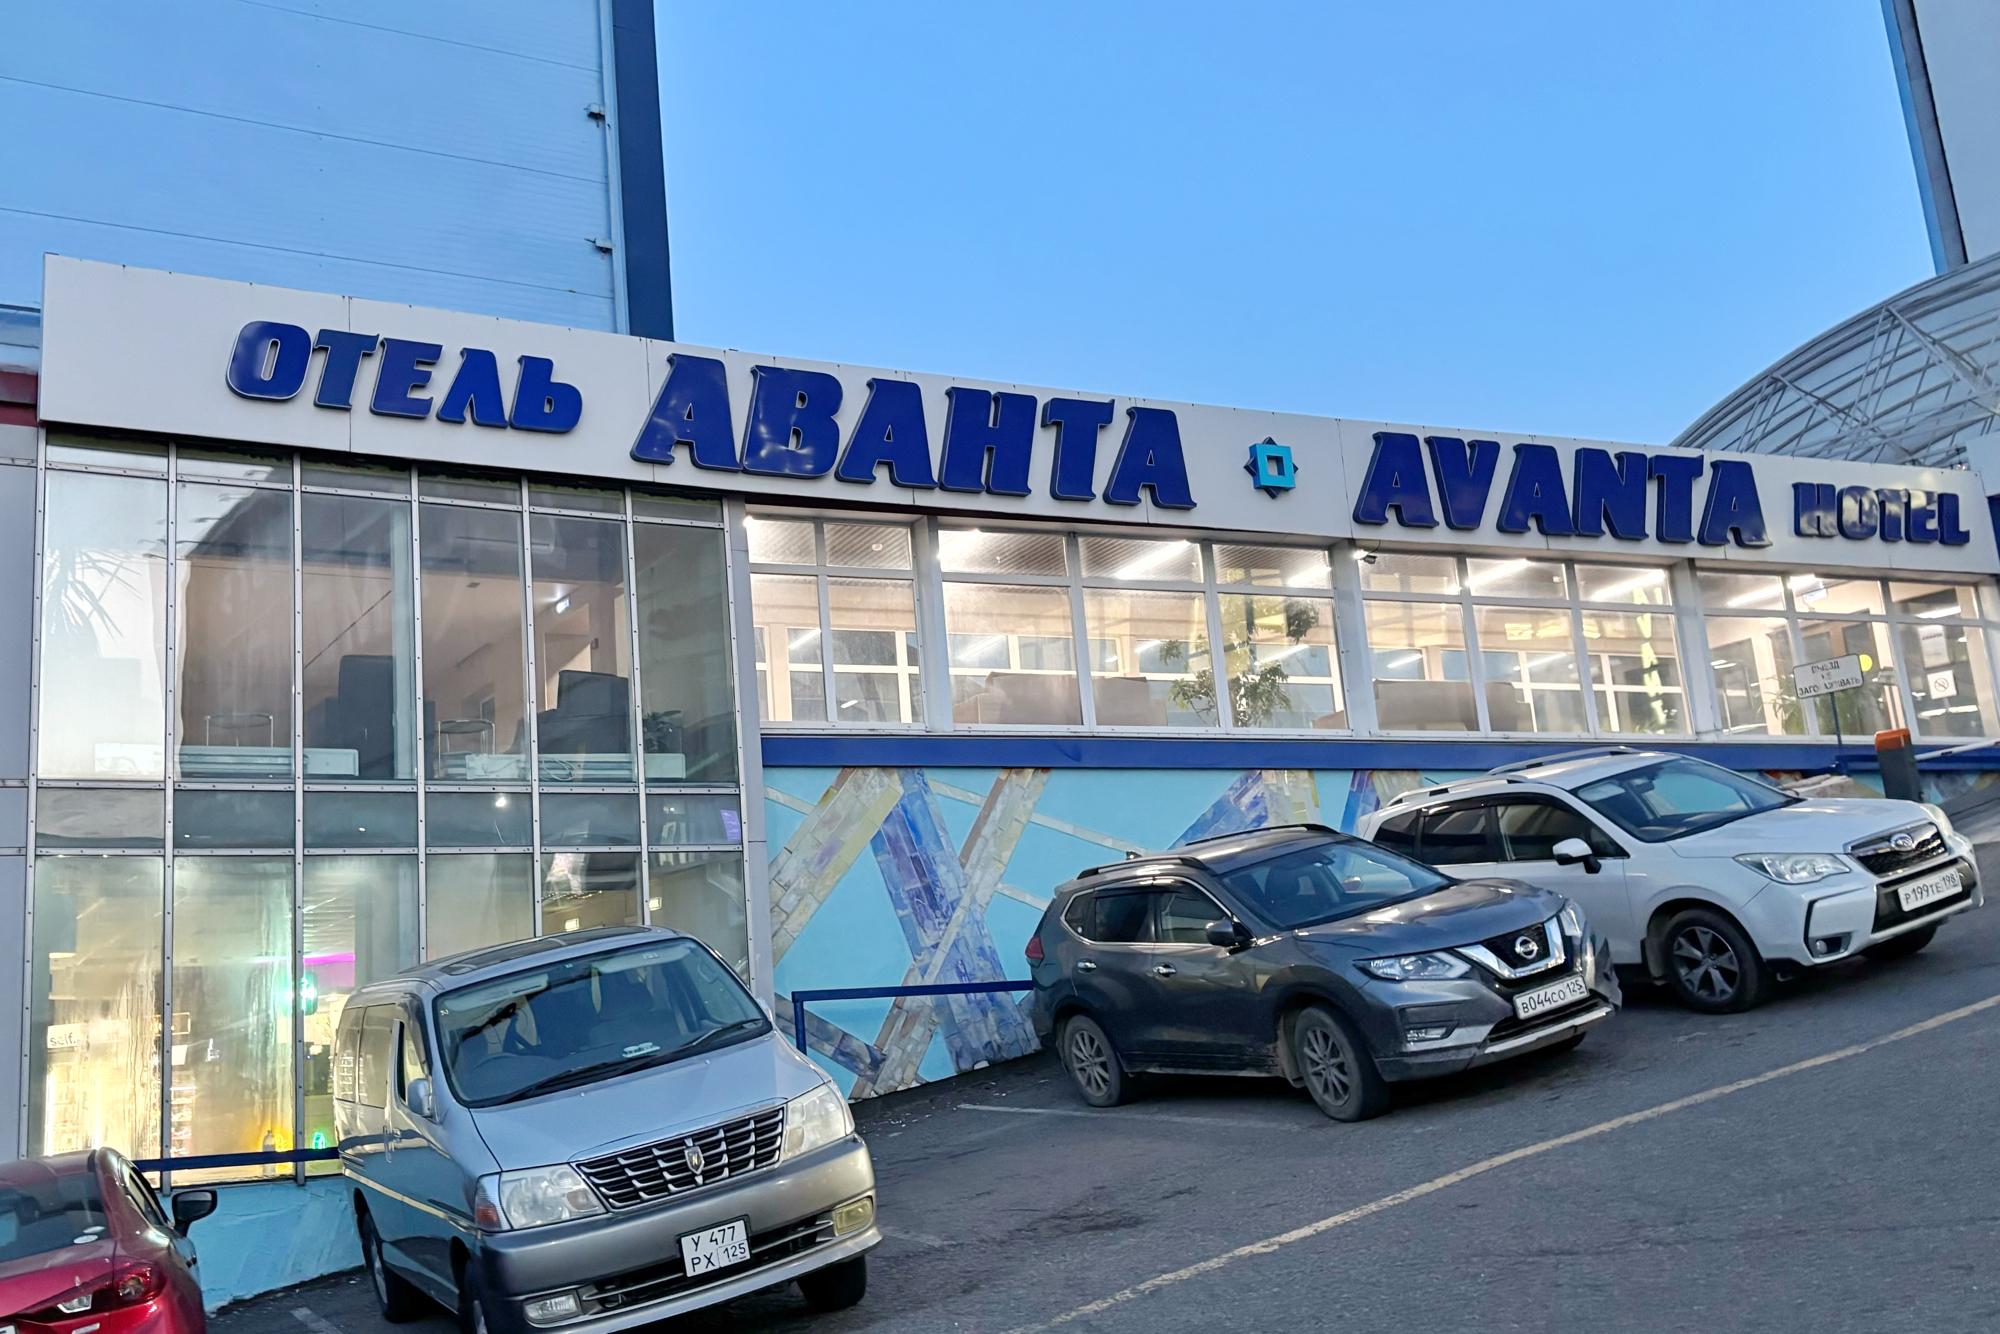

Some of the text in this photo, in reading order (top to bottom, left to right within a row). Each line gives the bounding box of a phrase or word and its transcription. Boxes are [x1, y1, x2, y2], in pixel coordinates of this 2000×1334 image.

[226, 320, 1197, 510] ОТЕЛЬ АВАНТА
[1352, 431, 1971, 549] AVANTA HOTEL
[1798, 677, 1861, 696] ЗАГОВАТЬ
[709, 1226, 735, 1245] 477
[723, 1242, 746, 1258] 125
